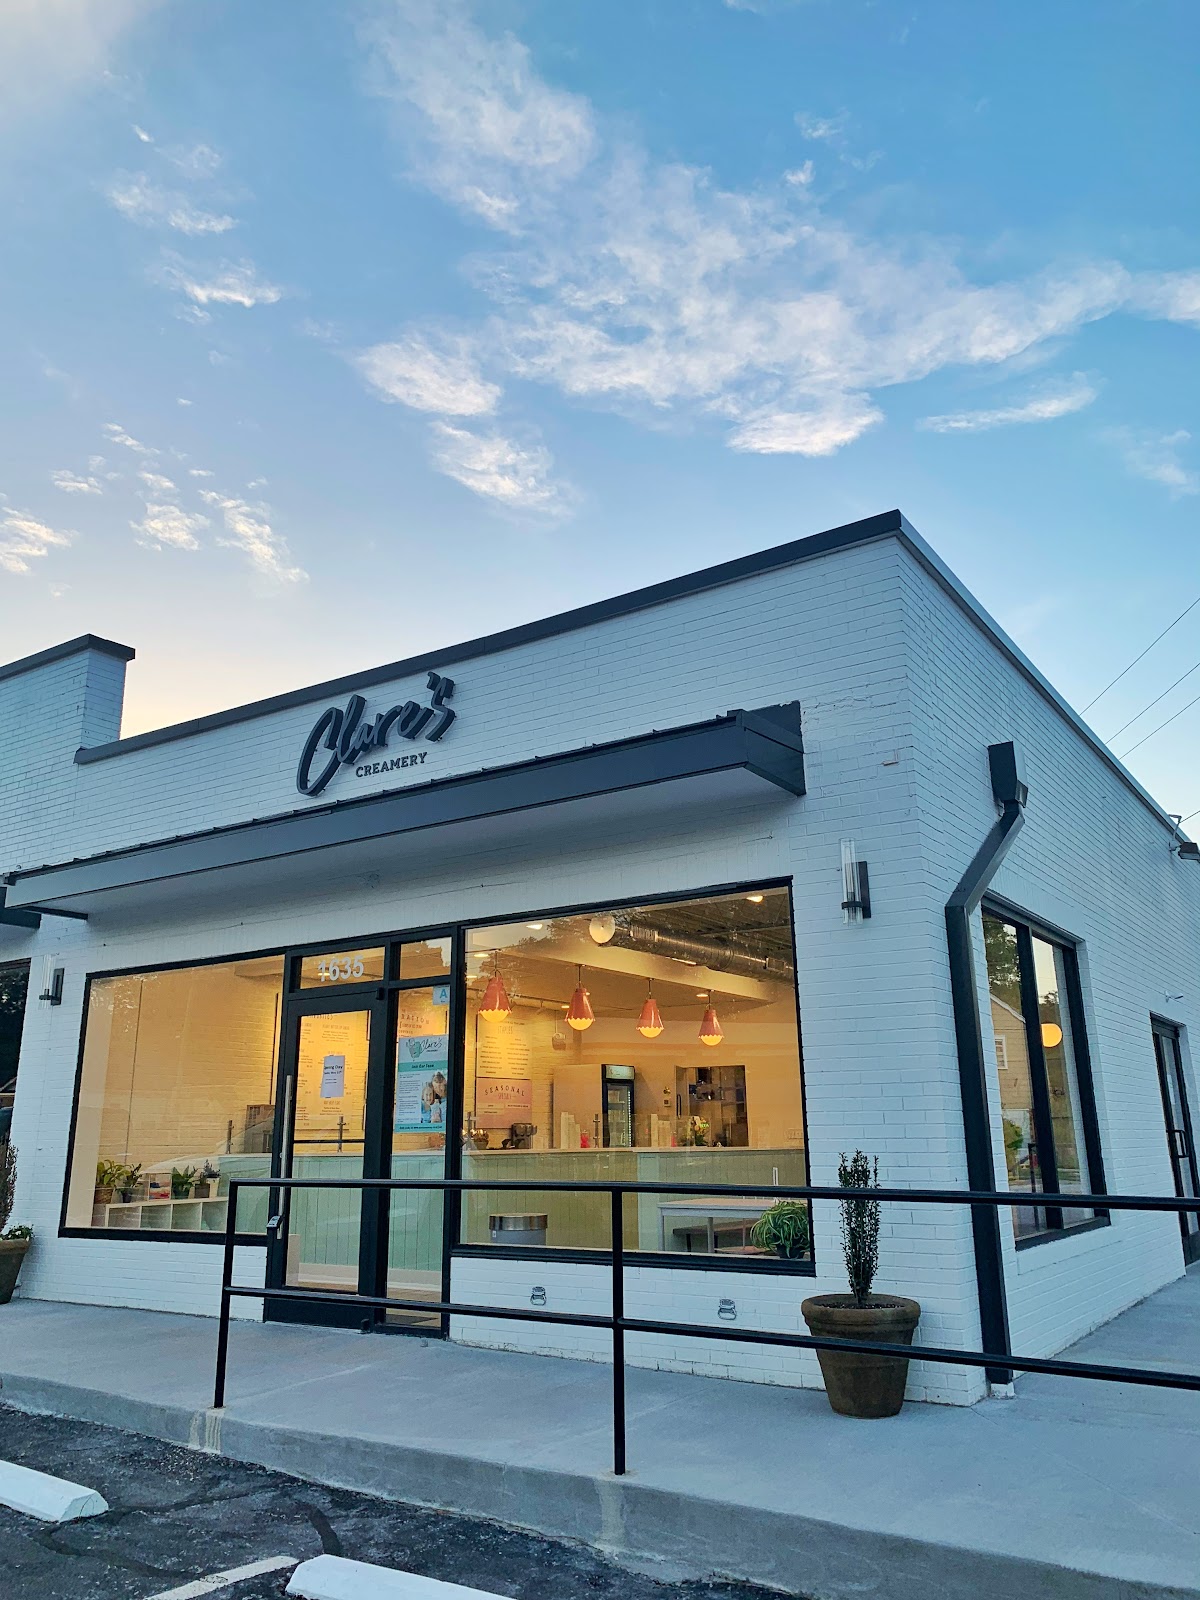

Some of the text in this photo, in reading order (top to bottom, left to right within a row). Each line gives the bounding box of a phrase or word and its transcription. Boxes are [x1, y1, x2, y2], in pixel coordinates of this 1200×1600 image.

[296, 671, 456, 797] Clare's
[355, 751, 428, 778] CREAMERY
[317, 955, 364, 982] 1635
[439, 988, 448, 998] A
[484, 1085, 525, 1097] SEASONAL
